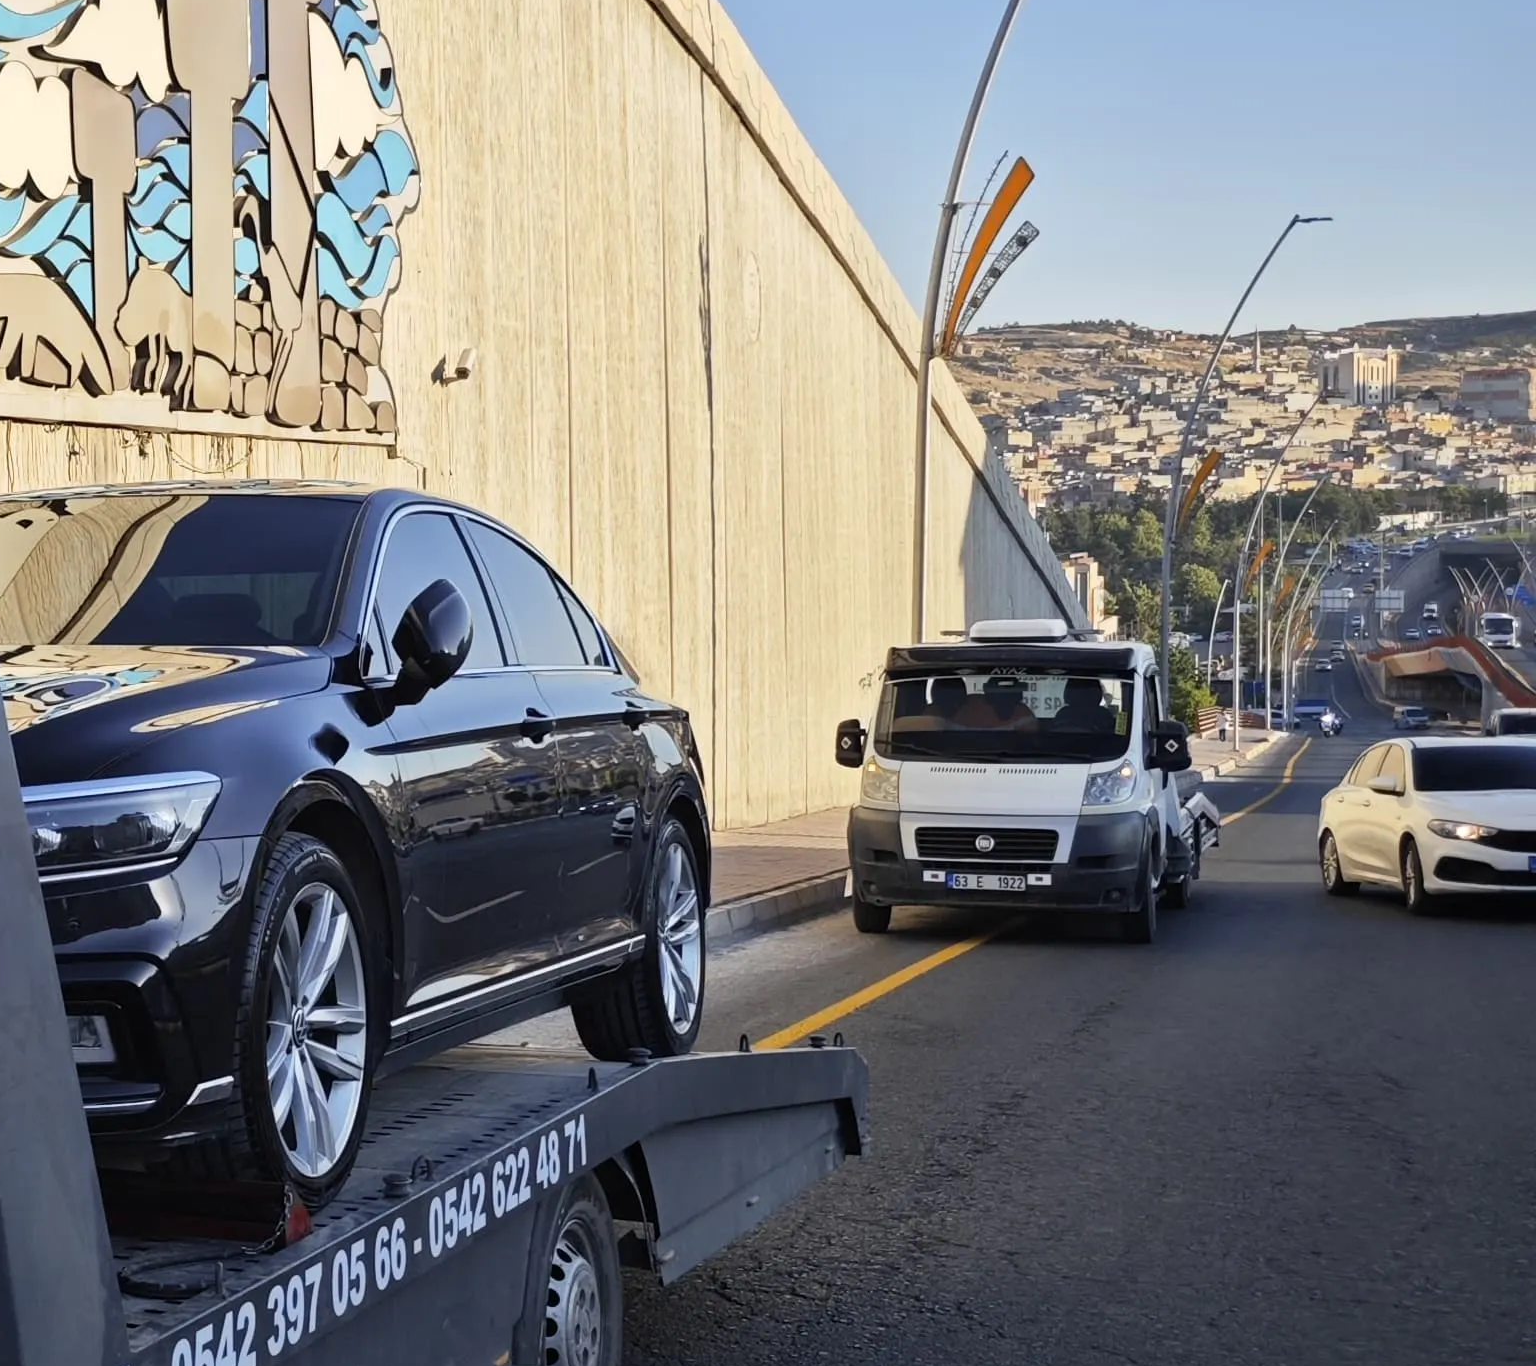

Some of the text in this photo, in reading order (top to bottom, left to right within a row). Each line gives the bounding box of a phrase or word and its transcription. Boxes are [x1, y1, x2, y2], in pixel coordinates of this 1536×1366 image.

[976, 876, 984, 888] E
[997, 876, 1024, 890] 1922
[267, 1262, 323, 1356] 397
[332, 1237, 366, 1317] 05
[375, 1217, 407, 1291] 66
[429, 1172, 487, 1258] 0542
[492, 1146, 532, 1219] 622
[536, 1130, 561, 1189] 48
[564, 1113, 587, 1175] 71
